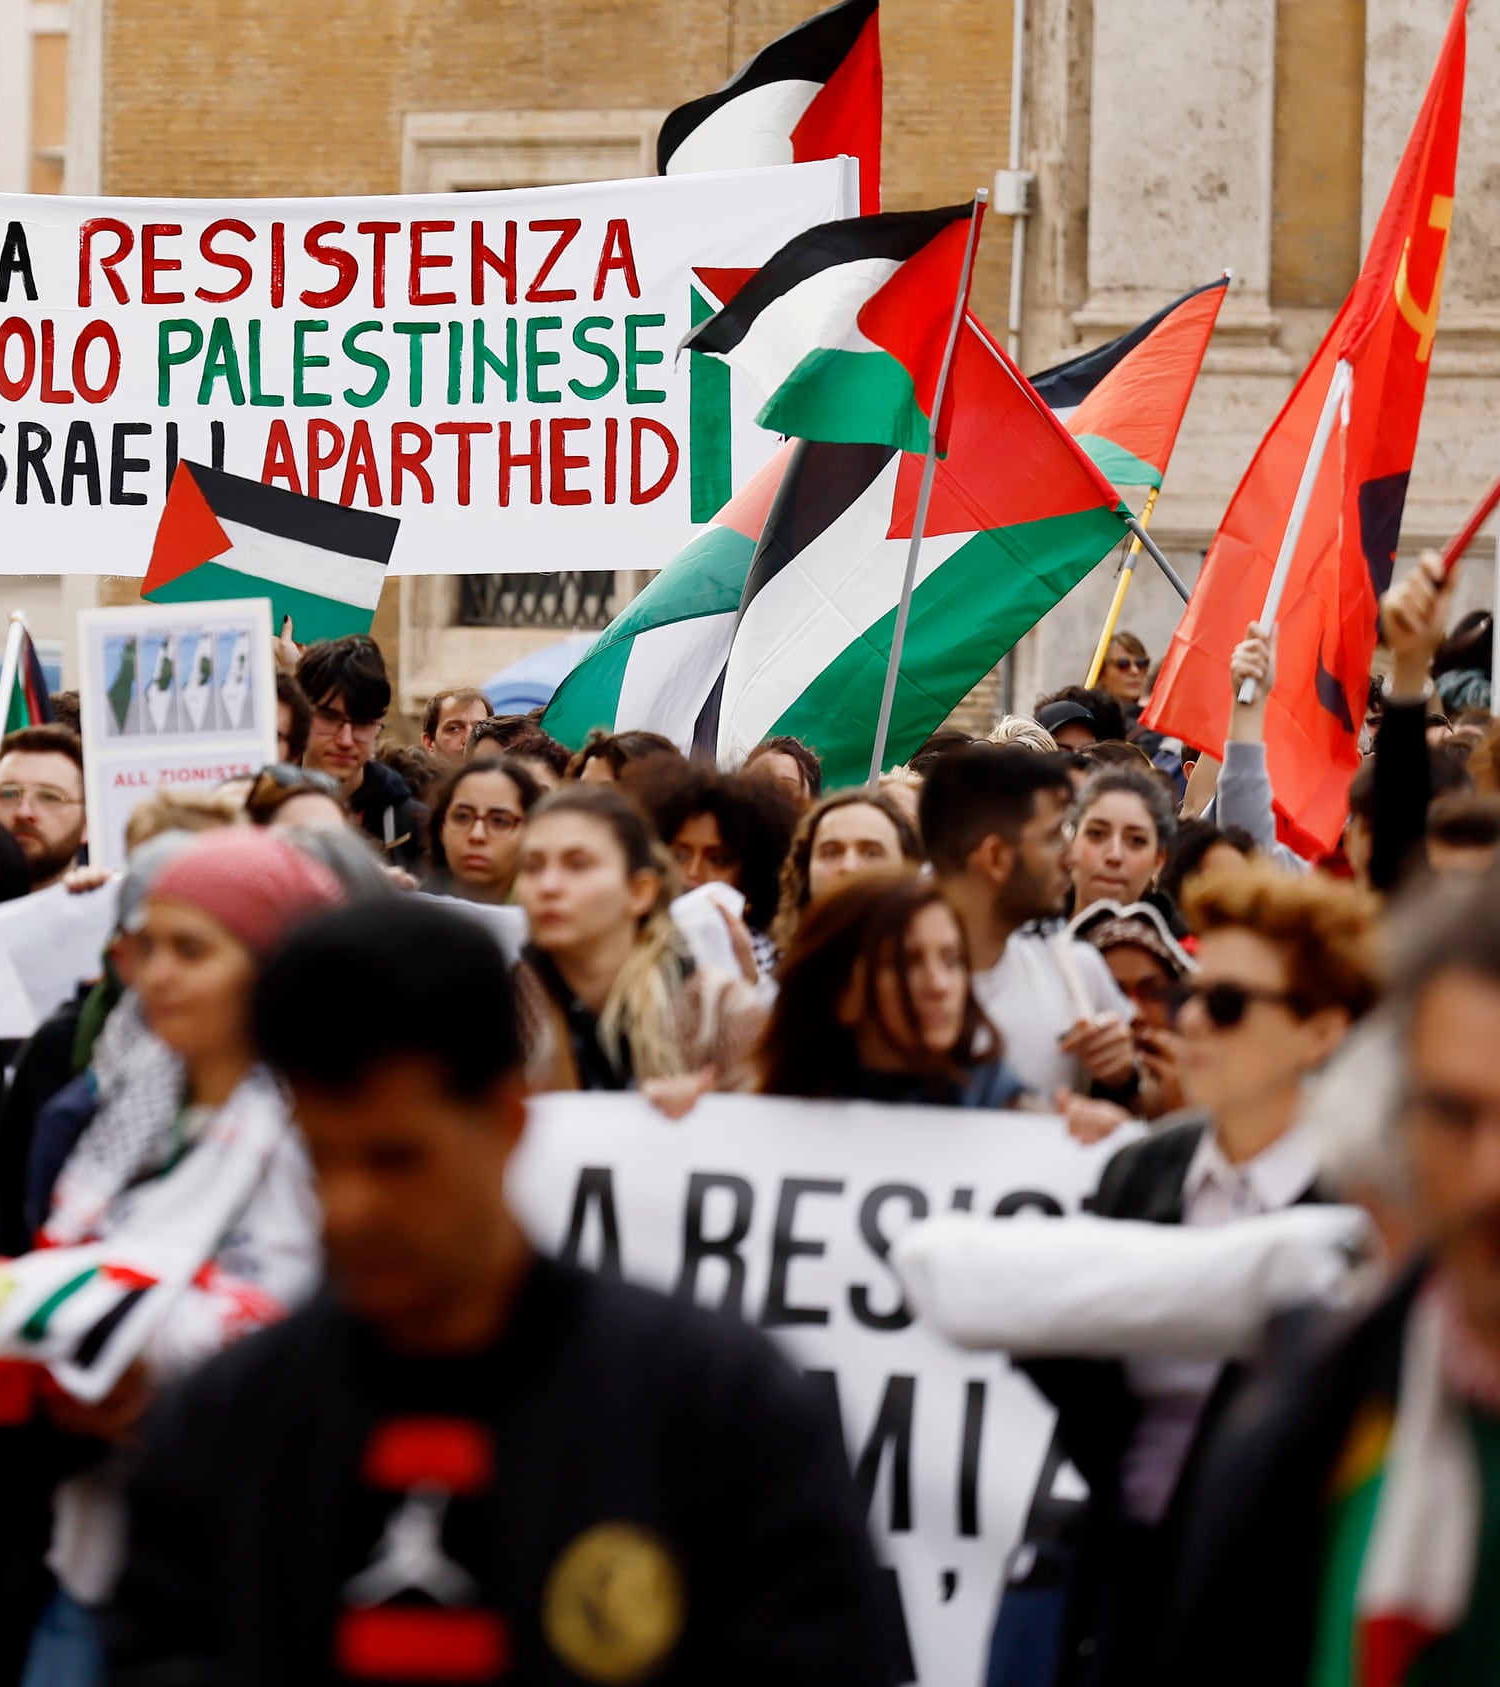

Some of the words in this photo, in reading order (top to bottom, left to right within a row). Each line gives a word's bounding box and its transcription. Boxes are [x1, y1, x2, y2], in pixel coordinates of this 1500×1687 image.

[78, 218, 641, 308] RESISTENZA
[158, 313, 666, 407] PALESTINESE
[261, 417, 679, 507] APARTHEID
[114, 771, 150, 787] ALL
